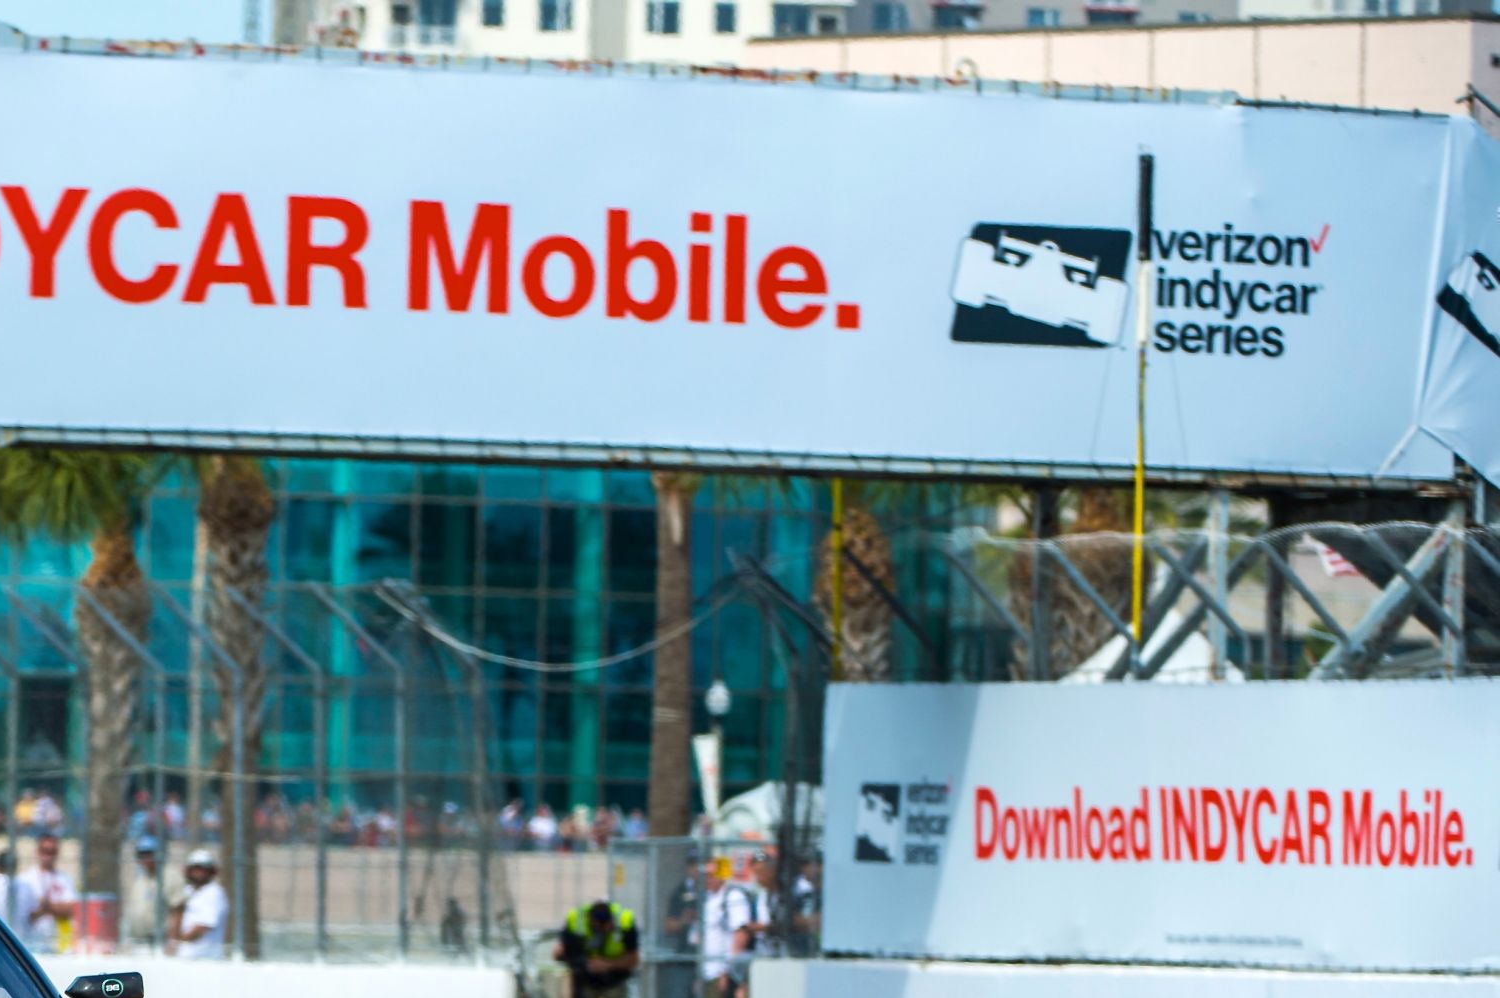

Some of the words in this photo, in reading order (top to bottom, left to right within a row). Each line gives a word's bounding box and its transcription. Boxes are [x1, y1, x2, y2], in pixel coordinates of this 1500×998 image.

[406, 200, 862, 330] Mobile.
[1152, 222, 1312, 268] verizon
[1155, 269, 1318, 317] indycar
[1153, 319, 1285, 357] series
[974, 786, 1151, 862] Download
[1161, 787, 1332, 867] INDYCAR
[1343, 789, 1474, 869] Mobile.
